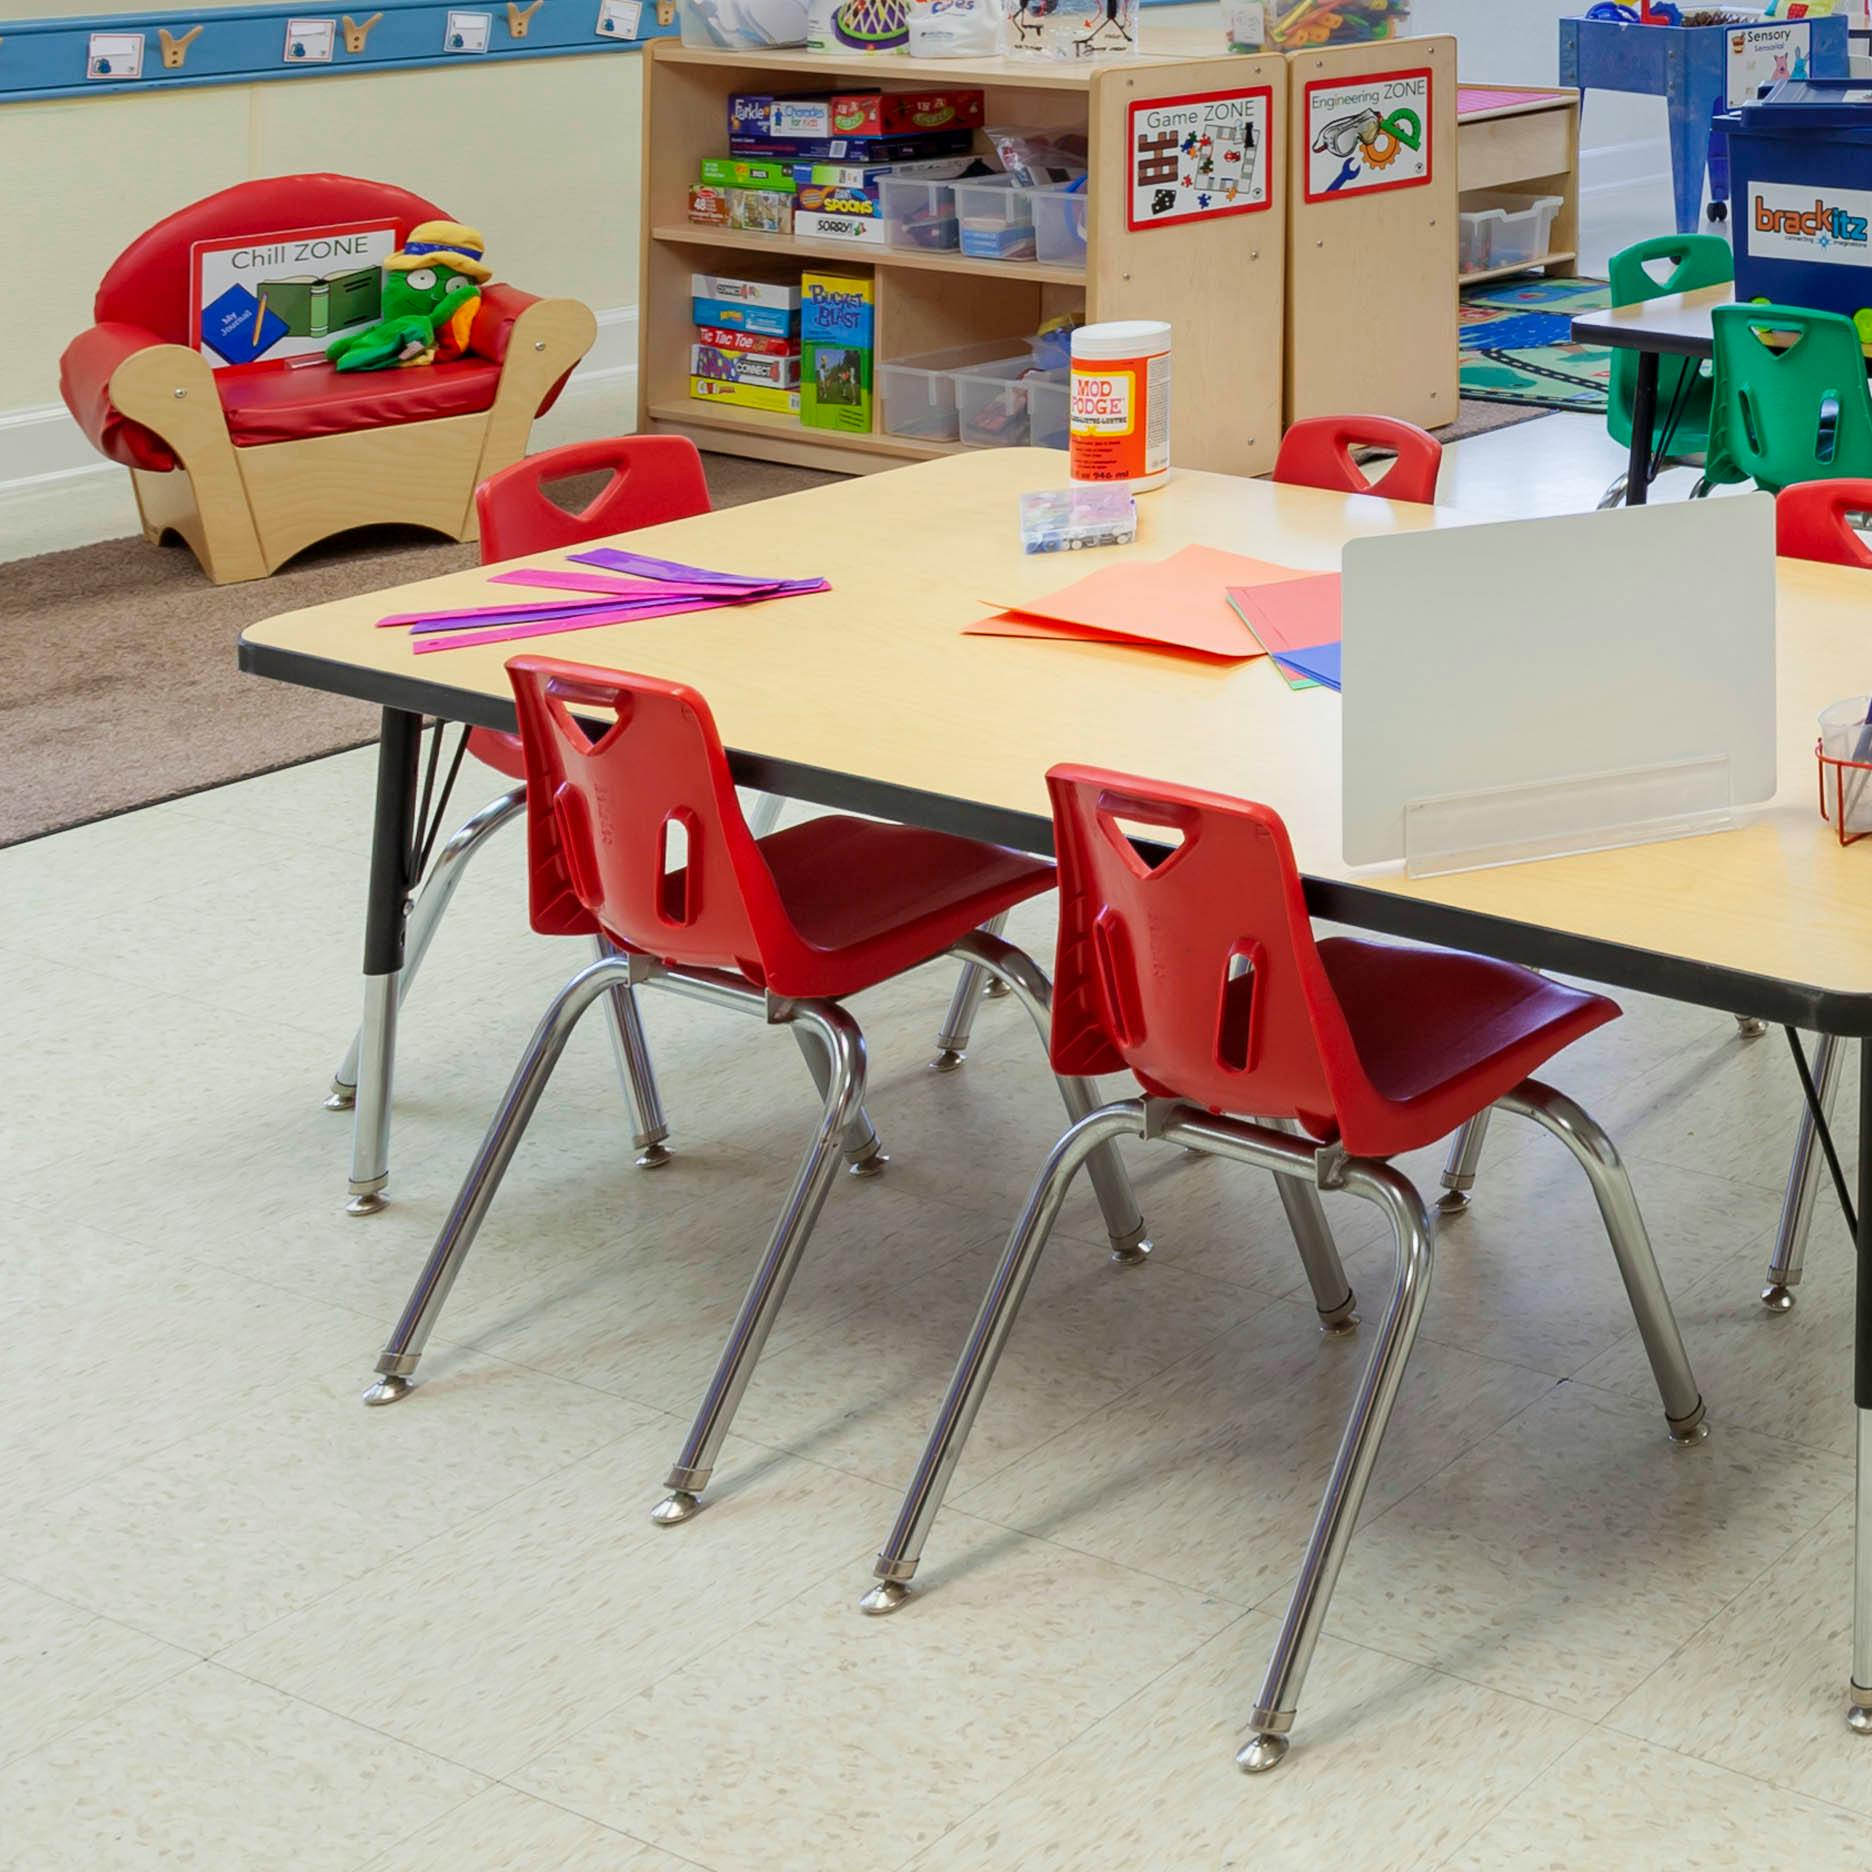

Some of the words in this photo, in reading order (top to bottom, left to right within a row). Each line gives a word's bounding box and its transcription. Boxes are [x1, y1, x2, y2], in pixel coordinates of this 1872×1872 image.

[1747, 29, 1791, 45] Sensory
[1312, 92, 1381, 111] Engineering
[1383, 79, 1426, 100] ZONE
[734, 98, 765, 121] Farkle
[1146, 108, 1199, 129] Game
[1204, 100, 1254, 122] ZONE
[824, 197, 874, 215] SPOONS
[1755, 195, 1868, 242] brackitz
[232, 246, 286, 269] Chill
[294, 235, 369, 263] ZONE
[808, 284, 864, 308] BUCKET
[219, 309, 254, 337] Journal
[222, 310, 239, 325] My
[815, 306, 863, 328] BLAST
[700, 327, 714, 343] Tic
[715, 330, 733, 345] Tac
[735, 333, 753, 348] Toe
[1077, 379, 1113, 397] MOD
[1093, 470, 1113, 479] 946
